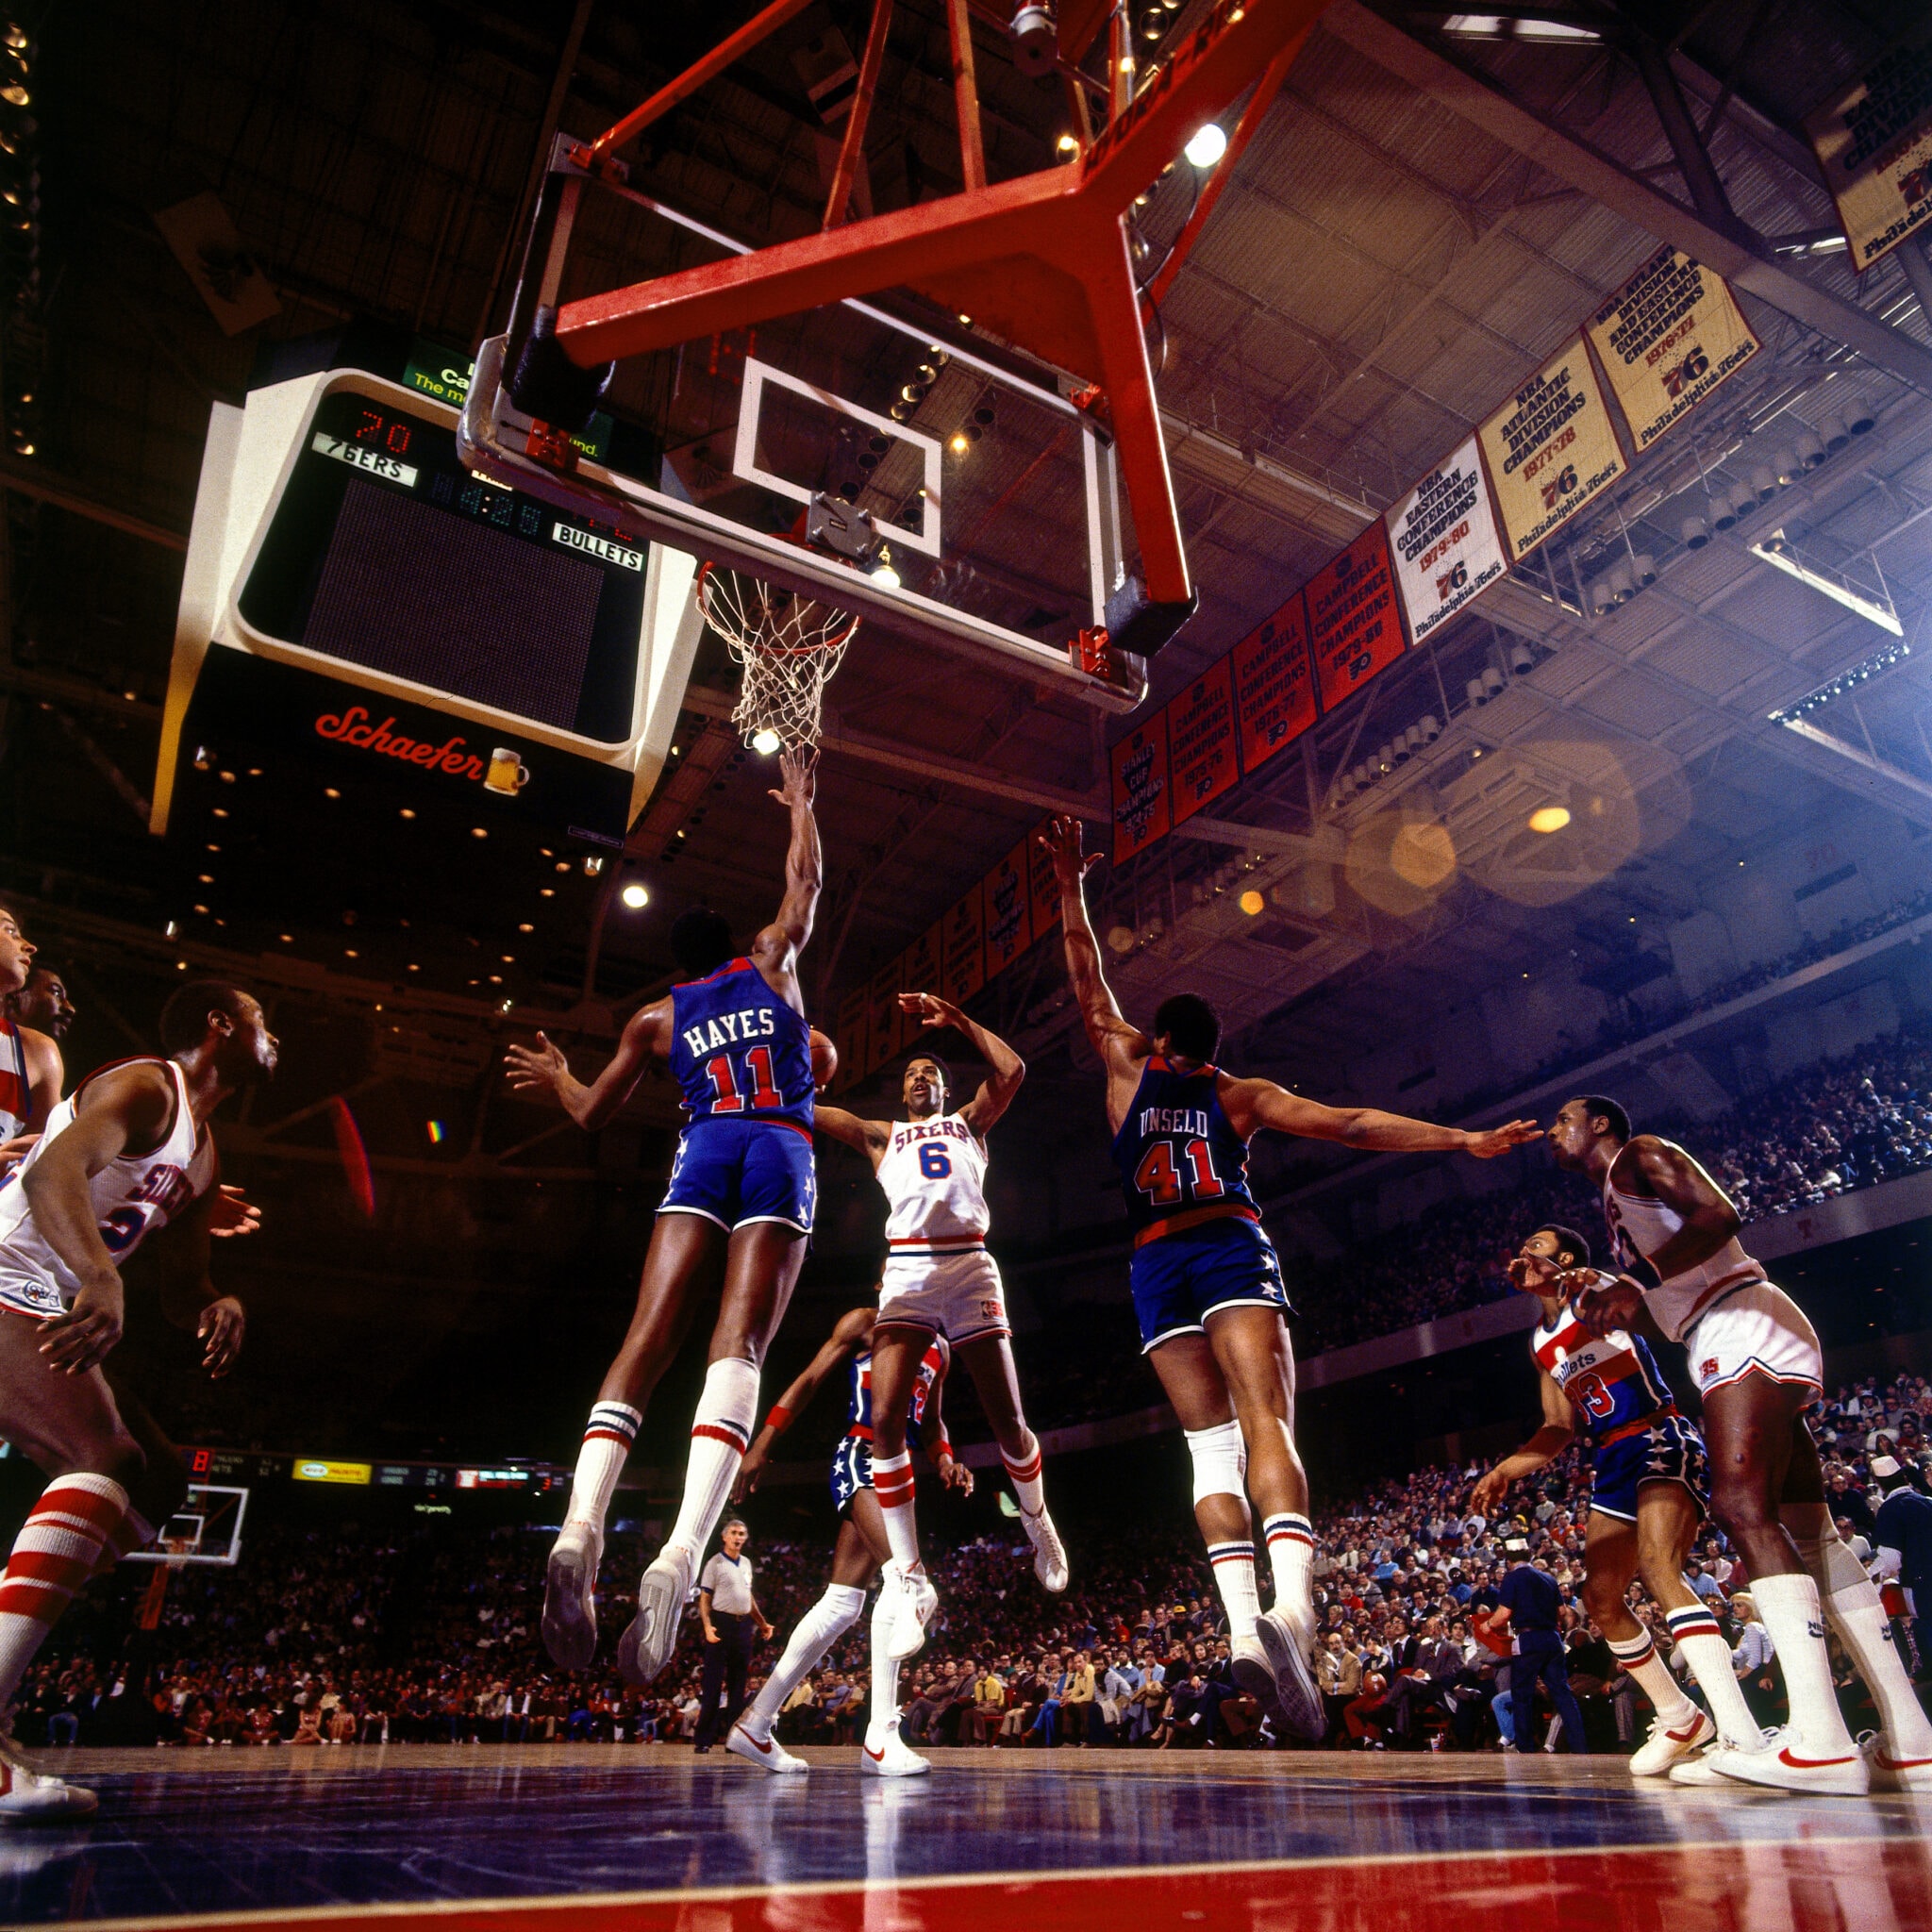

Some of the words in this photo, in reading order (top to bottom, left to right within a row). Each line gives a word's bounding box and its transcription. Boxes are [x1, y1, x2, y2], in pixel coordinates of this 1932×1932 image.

[1596, 297, 1624, 325] NBA
[1616, 270, 1703, 357] CONFERENCE
[1617, 259, 1678, 322] DIVISION
[1608, 319, 1639, 348] AND
[1624, 285, 1706, 366] CHAMPIONS
[414, 373, 443, 394] The
[1501, 367, 1572, 442] ATLANTIC
[1514, 374, 1547, 408] NBA
[1640, 368, 1721, 446] Philadelphia
[1718, 341, 1756, 376] 76ers
[1503, 391, 1587, 475] CHAMPIONS
[1507, 387, 1572, 454] DIVISION
[326, 436, 403, 478] 76ERS
[1416, 469, 1444, 501] NBA
[1396, 470, 1479, 553] CONFERENCE
[1404, 490, 1478, 563] CHAMPIONS
[1405, 467, 1462, 528] EASTERN
[1517, 485, 1587, 553] Philadelphia
[1585, 460, 1619, 494] 76ers
[558, 525, 640, 571] BULLETS
[1314, 567, 1390, 639] CONFERENCE
[1414, 583, 1475, 639] Philadelphia
[1474, 560, 1504, 592] 76ers
[1435, 559, 1469, 604] 76
[1321, 589, 1391, 659] CHAMPIONS
[1241, 639, 1306, 703] CONFERENCE
[1242, 659, 1307, 724] CHAMPIONS
[314, 706, 484, 781] Schaefer
[1173, 702, 1229, 756] CONFERENCE
[1174, 722, 1230, 774] CHAMPIONS
[683, 1008, 774, 1058] HAYES
[705, 1044, 785, 1115] 11
[894, 1120, 970, 1156] SIXERS
[1140, 1107, 1208, 1139] UNSELD
[917, 1141, 953, 1181] 6
[1133, 1138, 1225, 1207] 41
